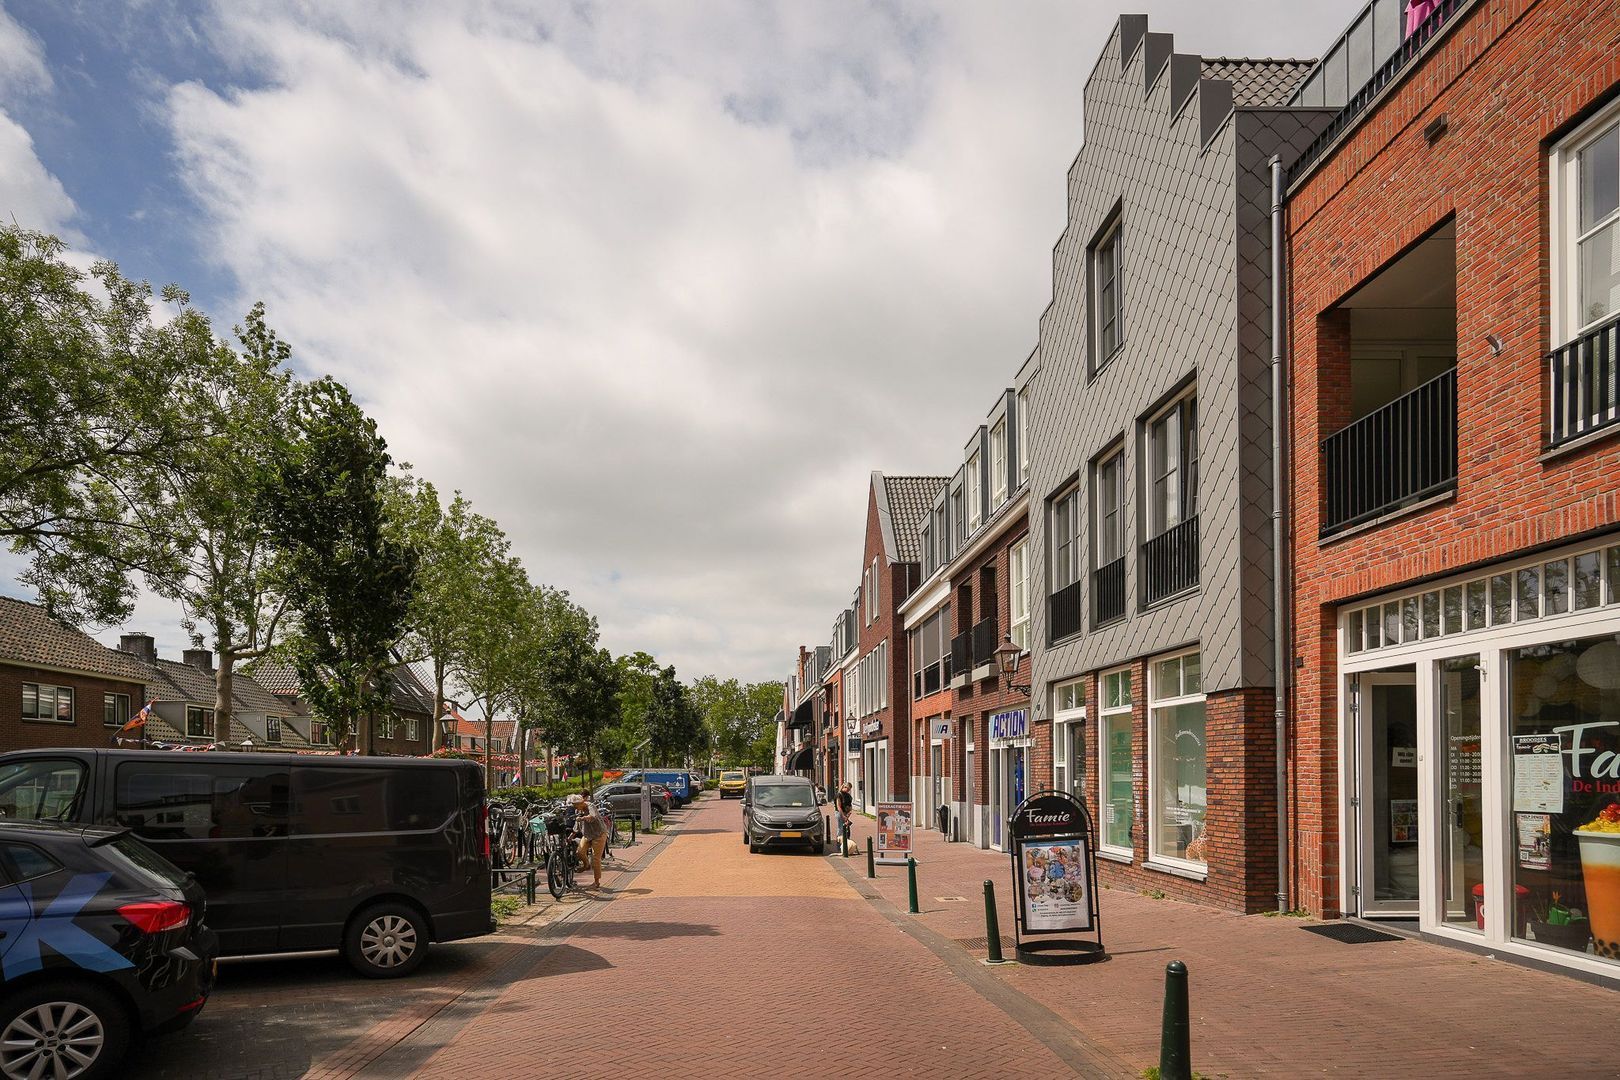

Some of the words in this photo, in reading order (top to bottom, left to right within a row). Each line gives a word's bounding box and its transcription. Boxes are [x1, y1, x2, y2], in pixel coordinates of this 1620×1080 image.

[993, 709, 1026, 738] ACTION
[1572, 780, 1592, 793] De
[1024, 807, 1070, 823] Famie
